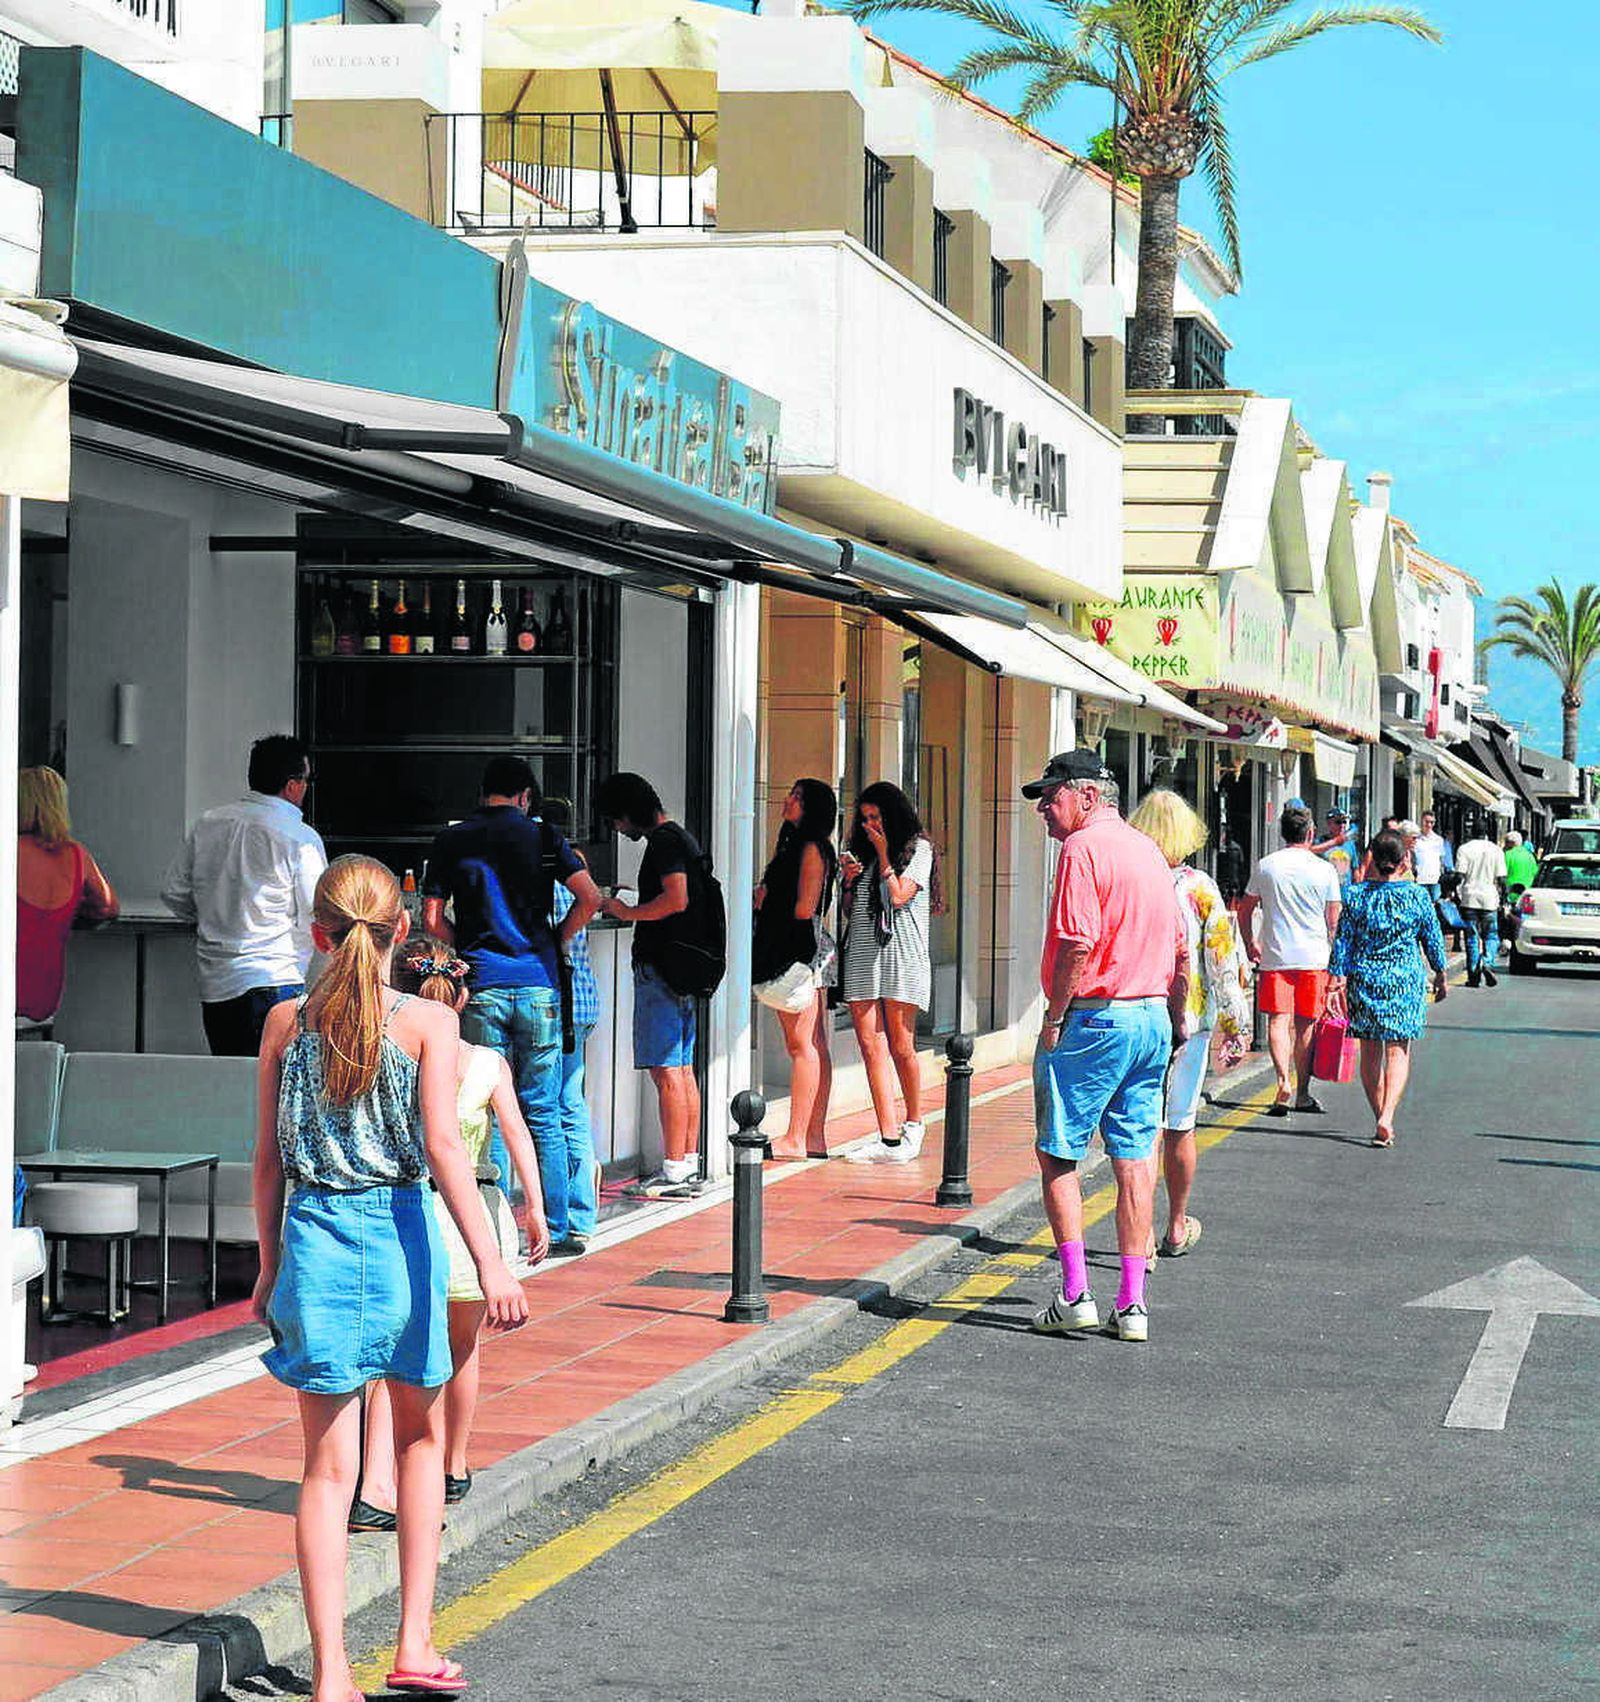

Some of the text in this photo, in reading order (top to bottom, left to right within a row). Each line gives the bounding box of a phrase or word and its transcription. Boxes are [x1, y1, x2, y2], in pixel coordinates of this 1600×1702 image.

[952, 387, 1068, 522] BVLGARI
[1077, 586, 1206, 610] AURANTE
[1131, 654, 1190, 677] PEPPER
